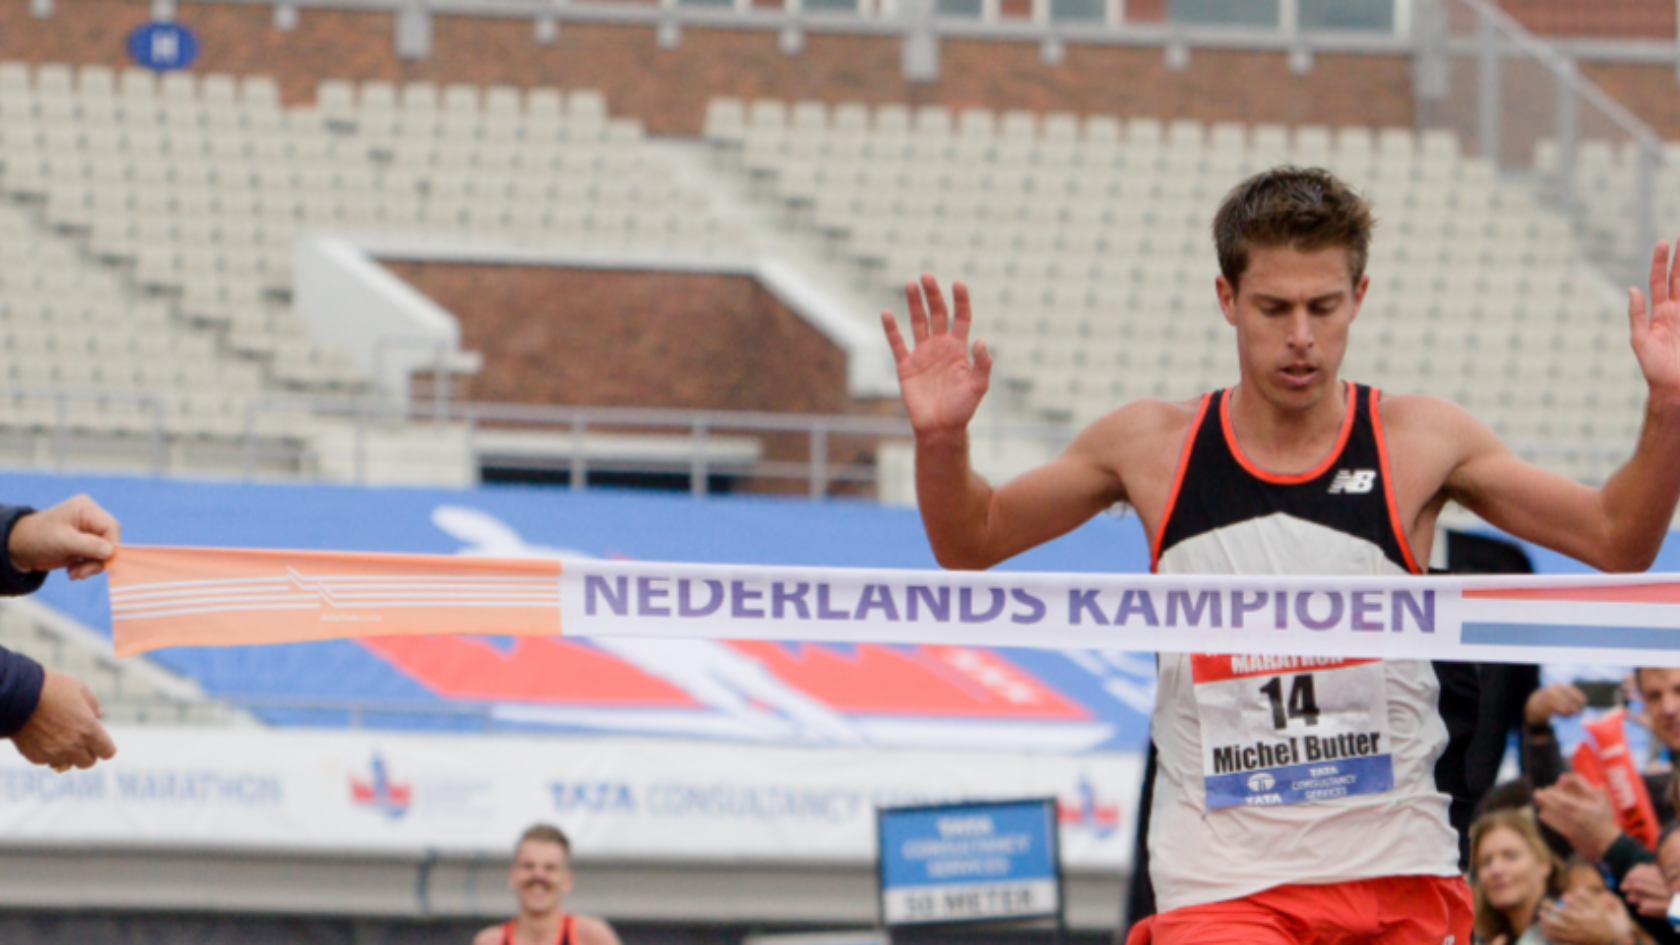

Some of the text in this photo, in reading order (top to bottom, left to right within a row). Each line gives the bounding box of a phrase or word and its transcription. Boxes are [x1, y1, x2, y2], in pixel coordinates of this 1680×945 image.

[583, 574, 1436, 633] NEDERLANDS KAMPIOEN
[1259, 672, 1320, 730] 14
[1212, 732, 1380, 774] Michel Butter
[1291, 774, 1357, 790] CONSULTANCY
[1309, 766, 1339, 777] TATA
[548, 781, 637, 814] TATA
[648, 783, 861, 820] CONSULTANCY
[1245, 794, 1283, 805] TATA
[1304, 787, 1348, 800] SERVICES
[937, 816, 994, 837] TATA
